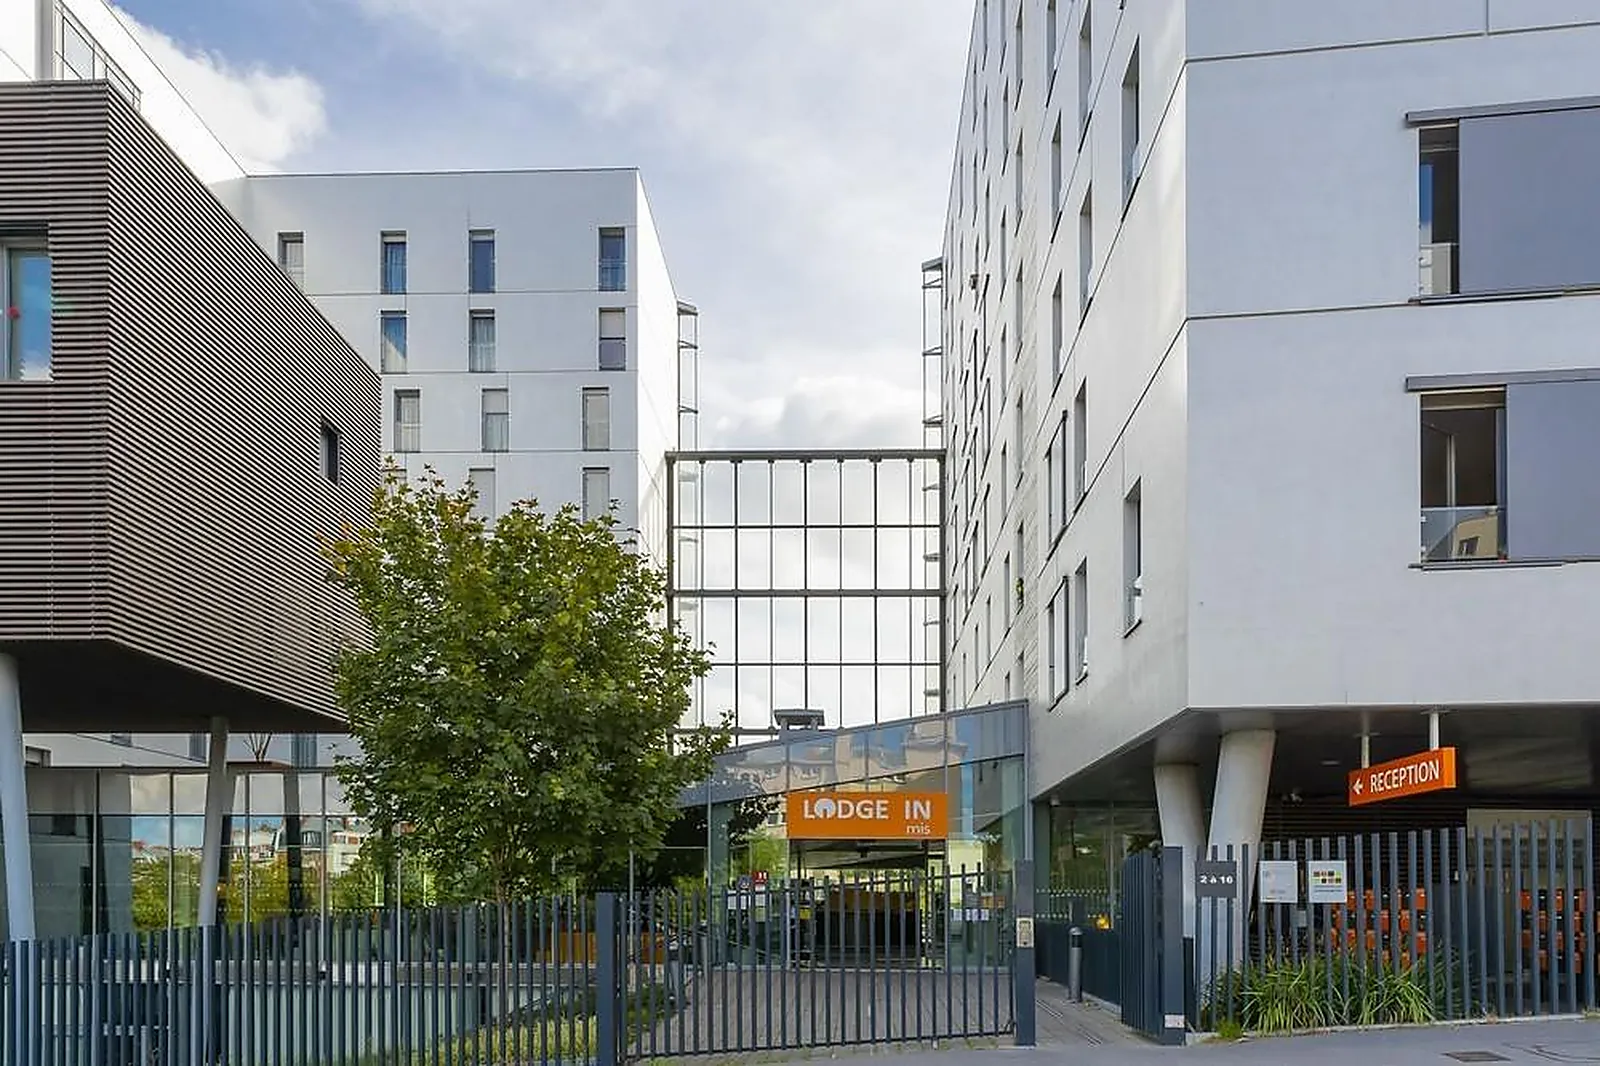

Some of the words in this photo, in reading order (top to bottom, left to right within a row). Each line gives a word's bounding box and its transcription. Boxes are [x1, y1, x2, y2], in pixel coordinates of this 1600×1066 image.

[1370, 759, 1440, 793] RECEPTION
[803, 798, 889, 820] LODGE
[904, 799, 931, 820] IN
[906, 822, 931, 834] mis
[1200, 875, 1208, 884] 2
